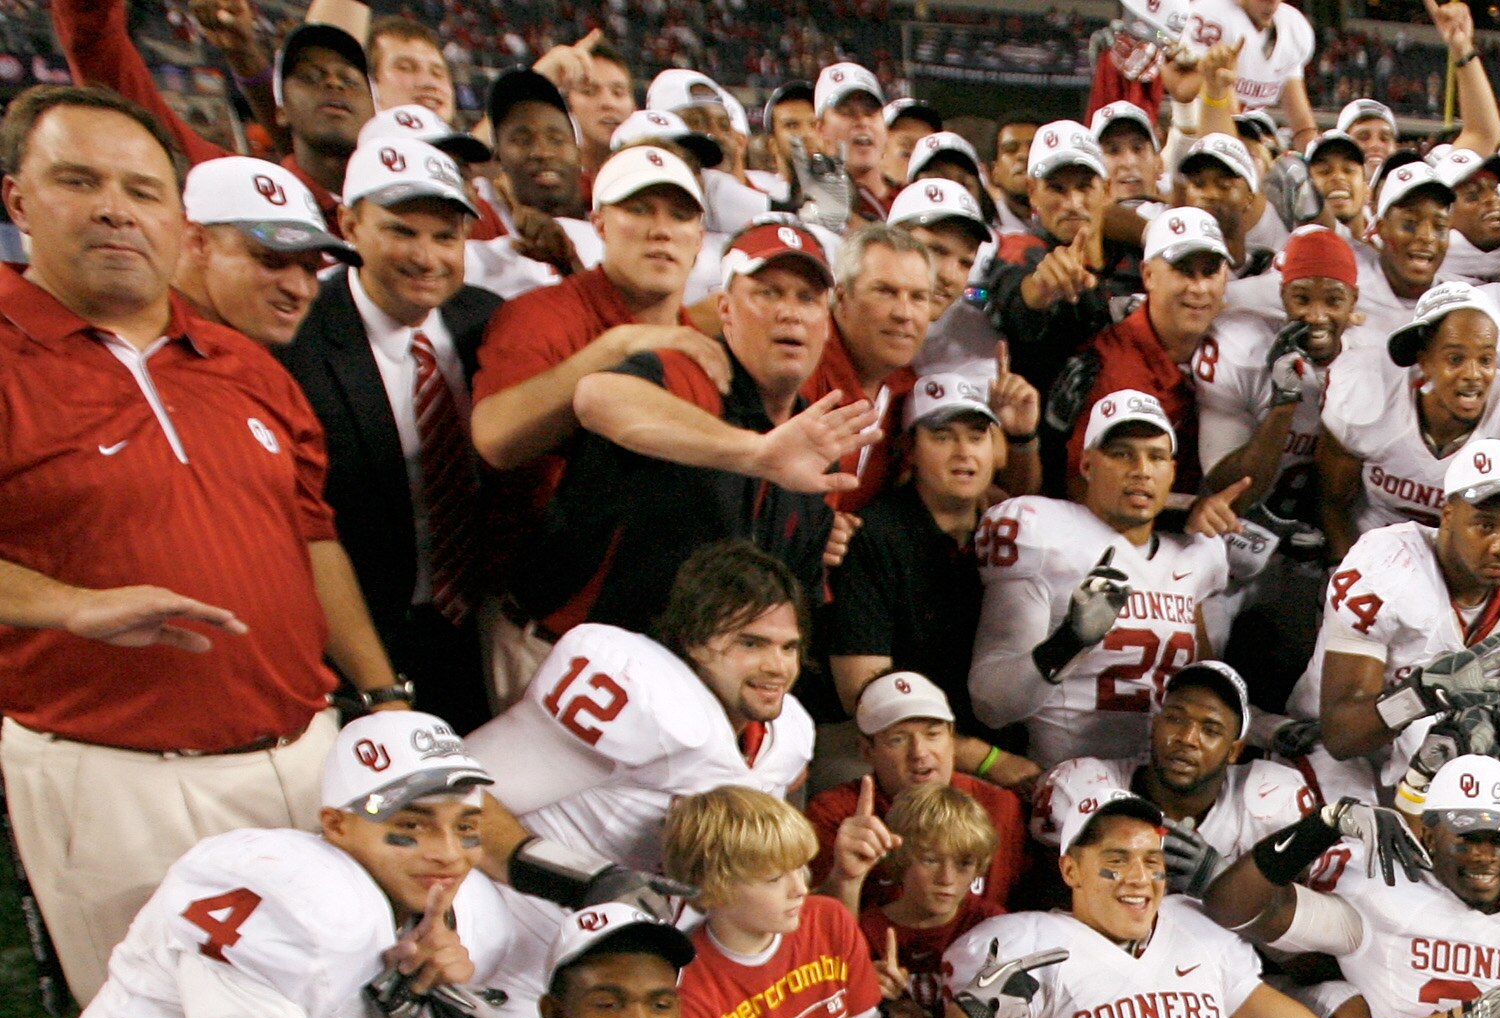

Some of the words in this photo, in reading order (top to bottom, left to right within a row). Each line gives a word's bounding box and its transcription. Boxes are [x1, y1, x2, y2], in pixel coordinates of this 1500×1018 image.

[395, 111, 423, 129] OU
[1045, 131, 1058, 147] OU
[381, 148, 406, 172] OU
[256, 175, 287, 205] OU
[926, 185, 943, 202] OU
[1168, 217, 1185, 234] OU
[778, 227, 802, 249] OU
[1200, 338, 1220, 384] 8
[925, 381, 945, 398] OU
[1101, 400, 1117, 418] OU
[247, 417, 281, 454] OU
[1474, 453, 1492, 474] OU
[975, 518, 1020, 568] 28
[1113, 591, 1196, 623] OONERS
[1331, 567, 1384, 635] 44
[1096, 629, 1197, 711] 28
[545, 656, 628, 746] 12
[353, 738, 391, 772] OU
[1460, 774, 1480, 798] OU
[1079, 798, 1098, 814] OU
[182, 887, 262, 963] 4
[579, 911, 607, 931] OU
